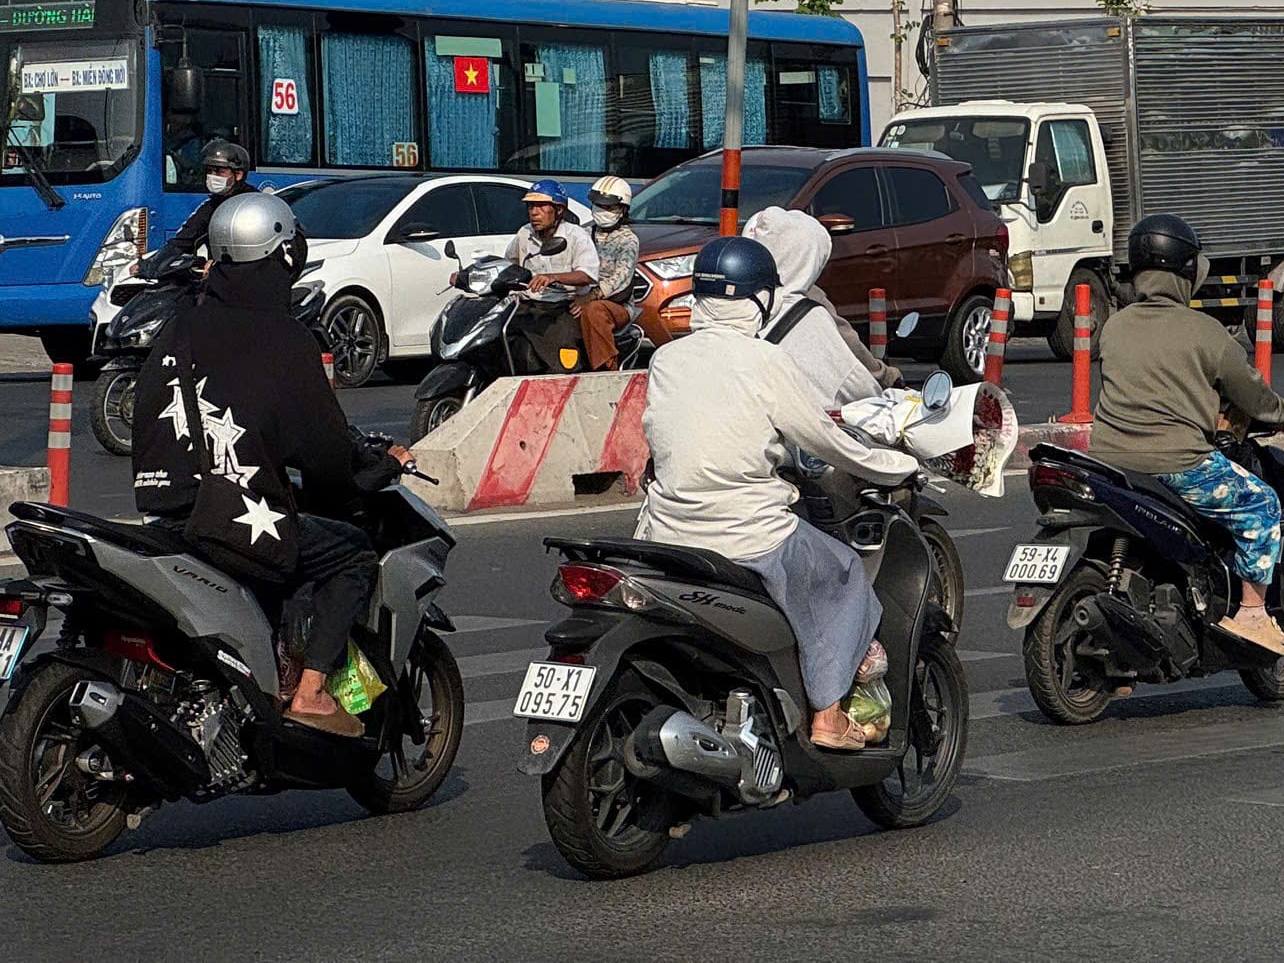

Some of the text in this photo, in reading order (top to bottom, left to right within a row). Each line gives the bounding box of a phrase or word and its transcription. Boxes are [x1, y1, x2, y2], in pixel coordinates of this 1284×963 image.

[274, 82, 296, 110] 56
[395, 143, 418, 167] 56
[172, 565, 229, 594] VARIO
[1008, 563, 1059, 581] 000.69
[714, 602, 746, 615] mode
[533, 667, 583, 691] 50-X1
[519, 691, 583, 718] 095.75
